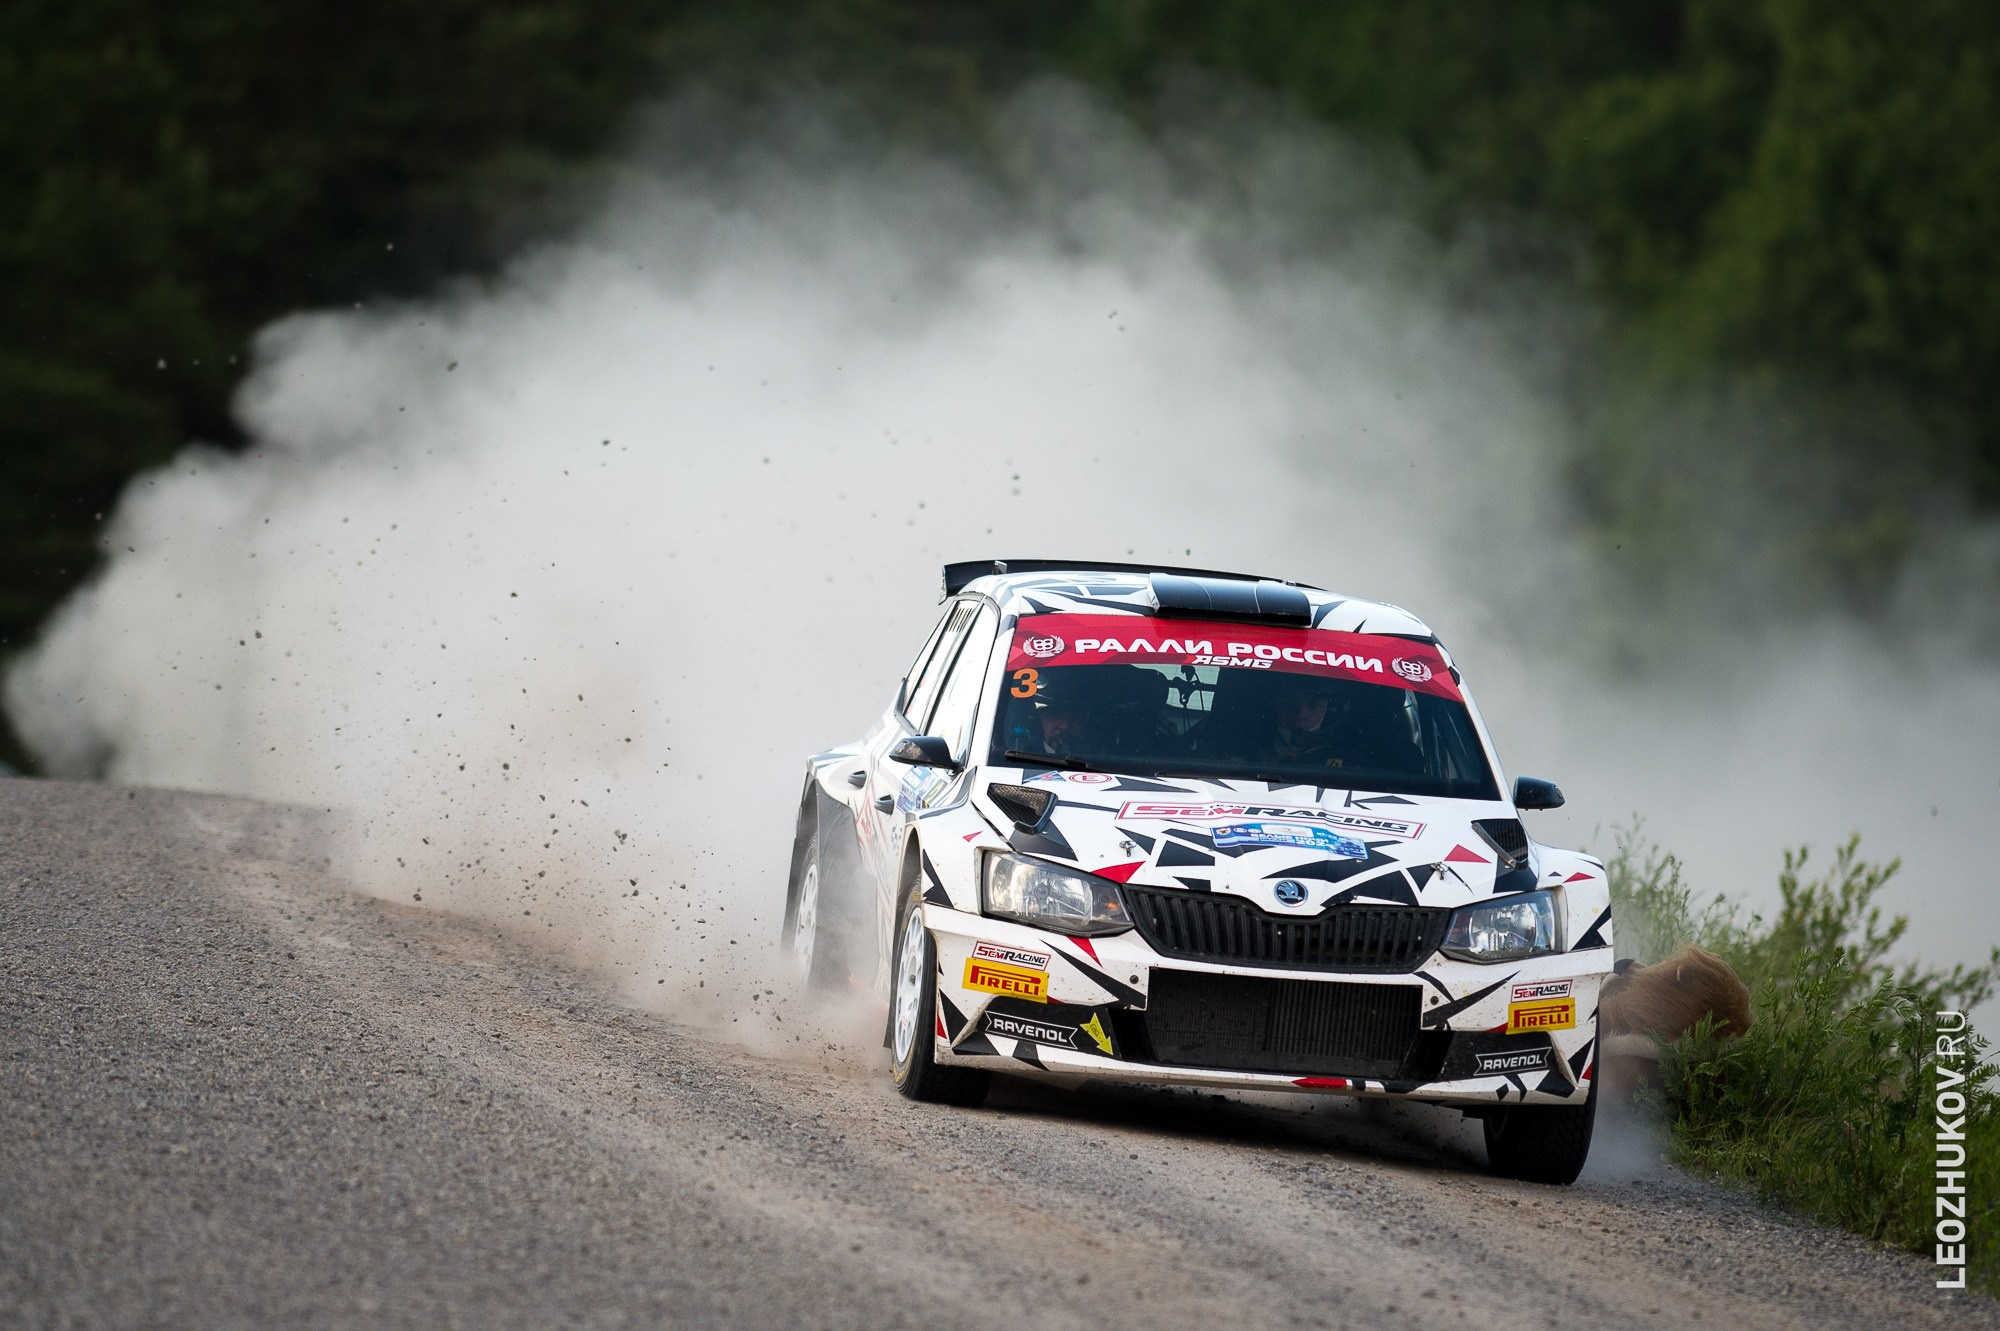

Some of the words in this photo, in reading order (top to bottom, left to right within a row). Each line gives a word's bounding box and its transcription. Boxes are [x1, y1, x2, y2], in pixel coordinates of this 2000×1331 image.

[1075, 638, 1213, 655] РАЛЛИ
[1227, 642, 1384, 673] РОССИИ
[1010, 668, 1039, 698] 3
[970, 965, 1042, 996] PIRELLI
[1513, 1004, 1570, 1028] PIRELLI
[993, 1018, 1068, 1043] RAVENOL
[1483, 1054, 1543, 1071] RAVENOL
